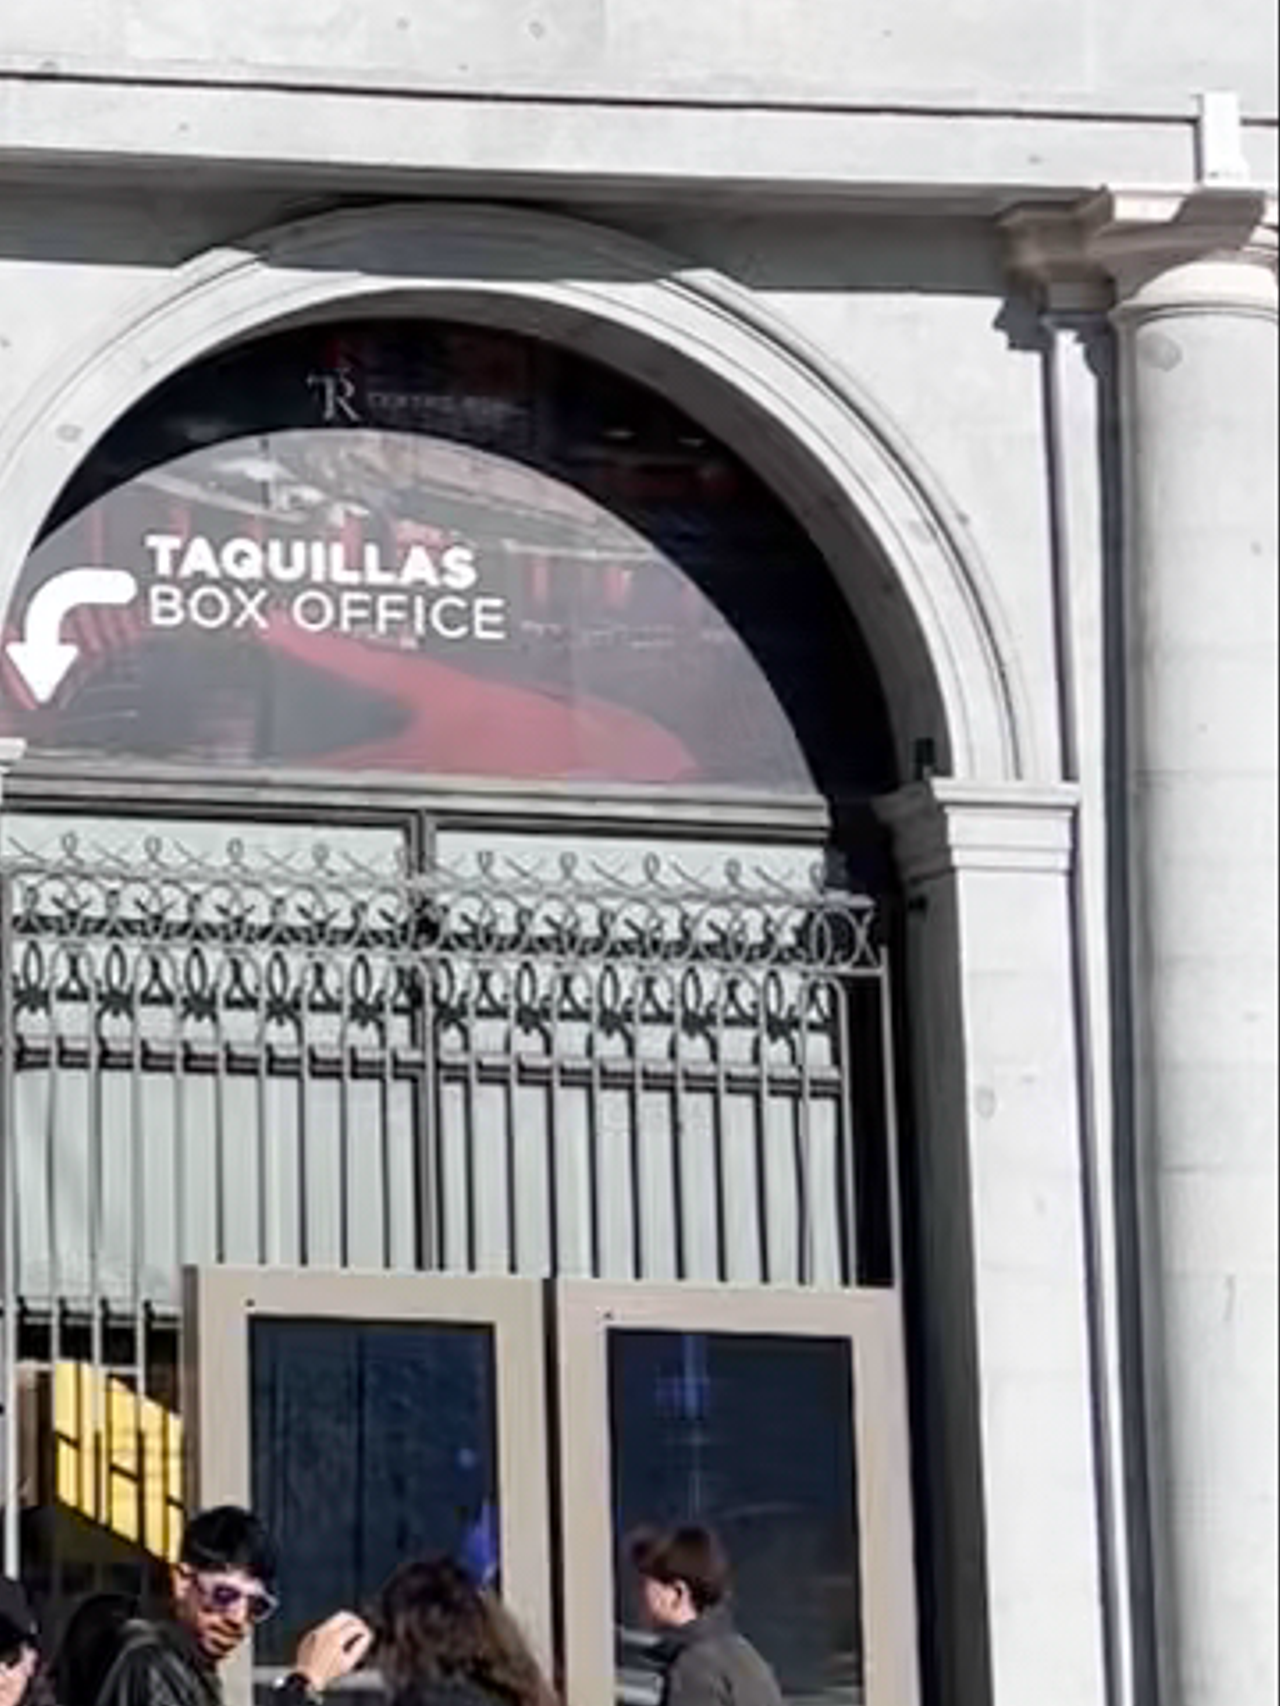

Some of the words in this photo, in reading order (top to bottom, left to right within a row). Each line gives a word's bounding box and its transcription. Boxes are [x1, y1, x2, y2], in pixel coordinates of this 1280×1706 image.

[145, 535, 477, 589] TAQUILLAS
[149, 586, 269, 629] BOX
[292, 590, 506, 639] OFFICE
